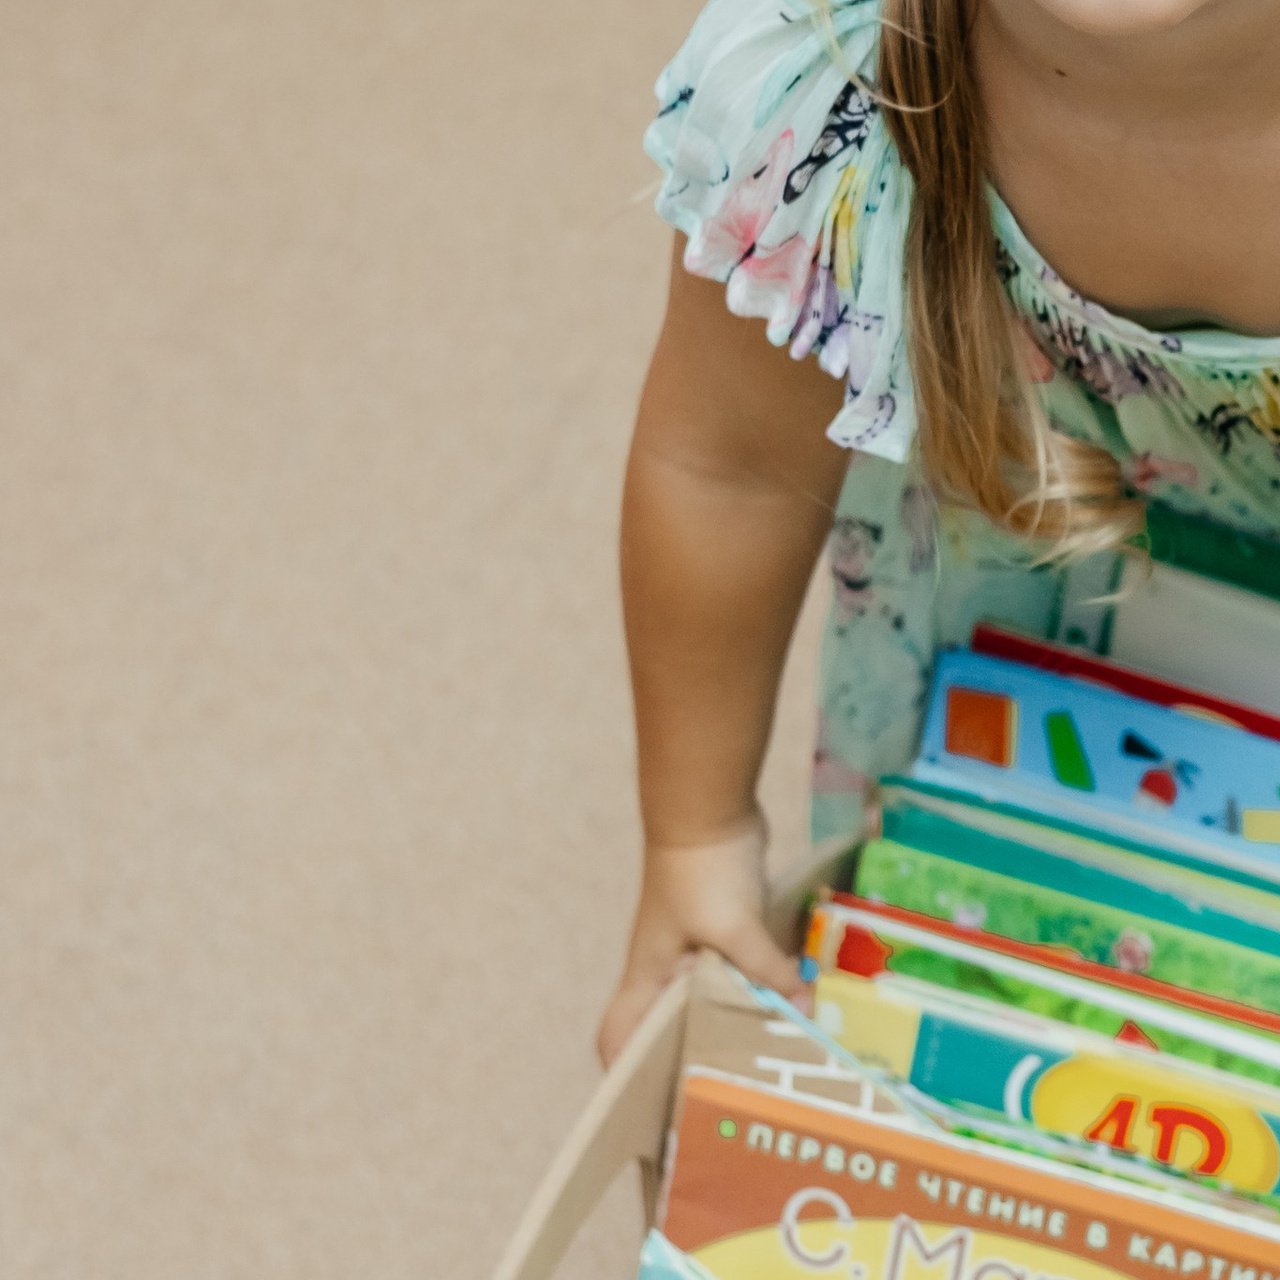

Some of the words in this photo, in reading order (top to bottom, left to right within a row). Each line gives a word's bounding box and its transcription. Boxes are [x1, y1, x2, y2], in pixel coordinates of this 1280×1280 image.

[747, 1122, 899, 1190] ПЕРВОЕ
[917, 1172, 1067, 1238] ЧТЕНИЕ
[1086, 1220, 1108, 1250] В
